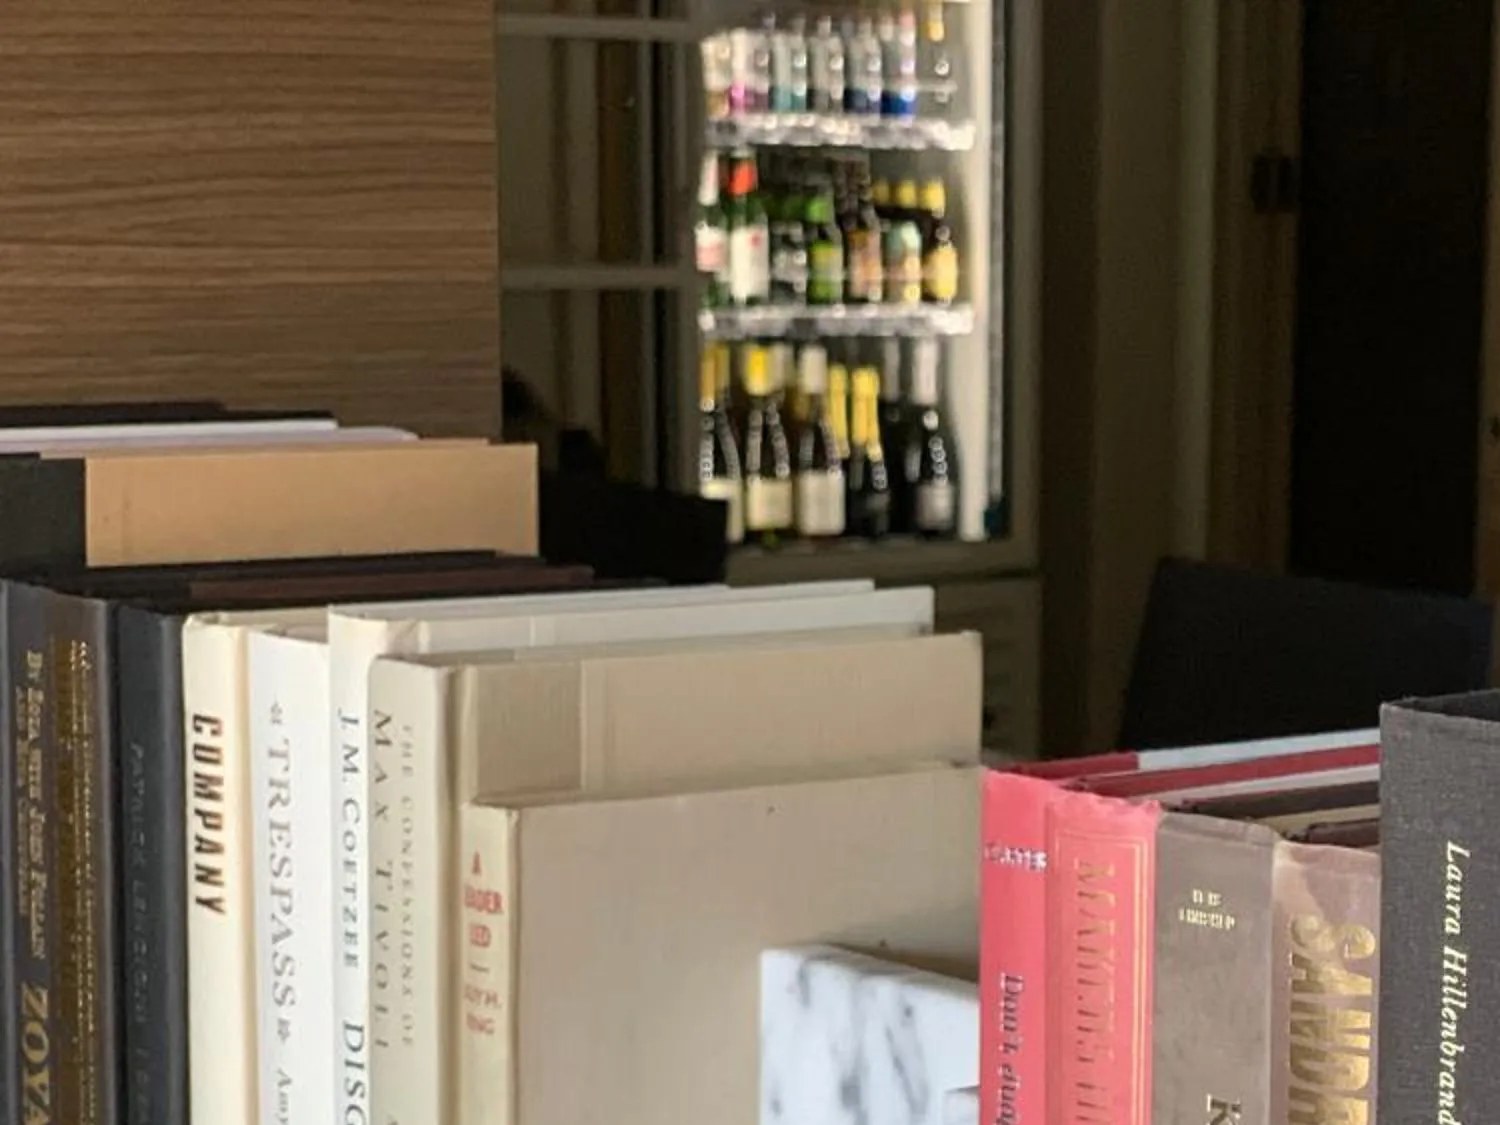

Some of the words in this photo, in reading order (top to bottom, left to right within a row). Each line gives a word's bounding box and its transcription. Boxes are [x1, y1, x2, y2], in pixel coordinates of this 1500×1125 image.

[129, 743, 146, 867] PATRICK
[192, 713, 226, 916] COMPANY
[374, 708, 393, 824] MAX
[268, 738, 297, 1009] TRESPASS
[1444, 840, 1472, 936] Laura
[374, 858, 394, 1050] TIVOLI
[999, 974, 1026, 1052] Don't
[1073, 858, 1116, 1062] MAKERS
